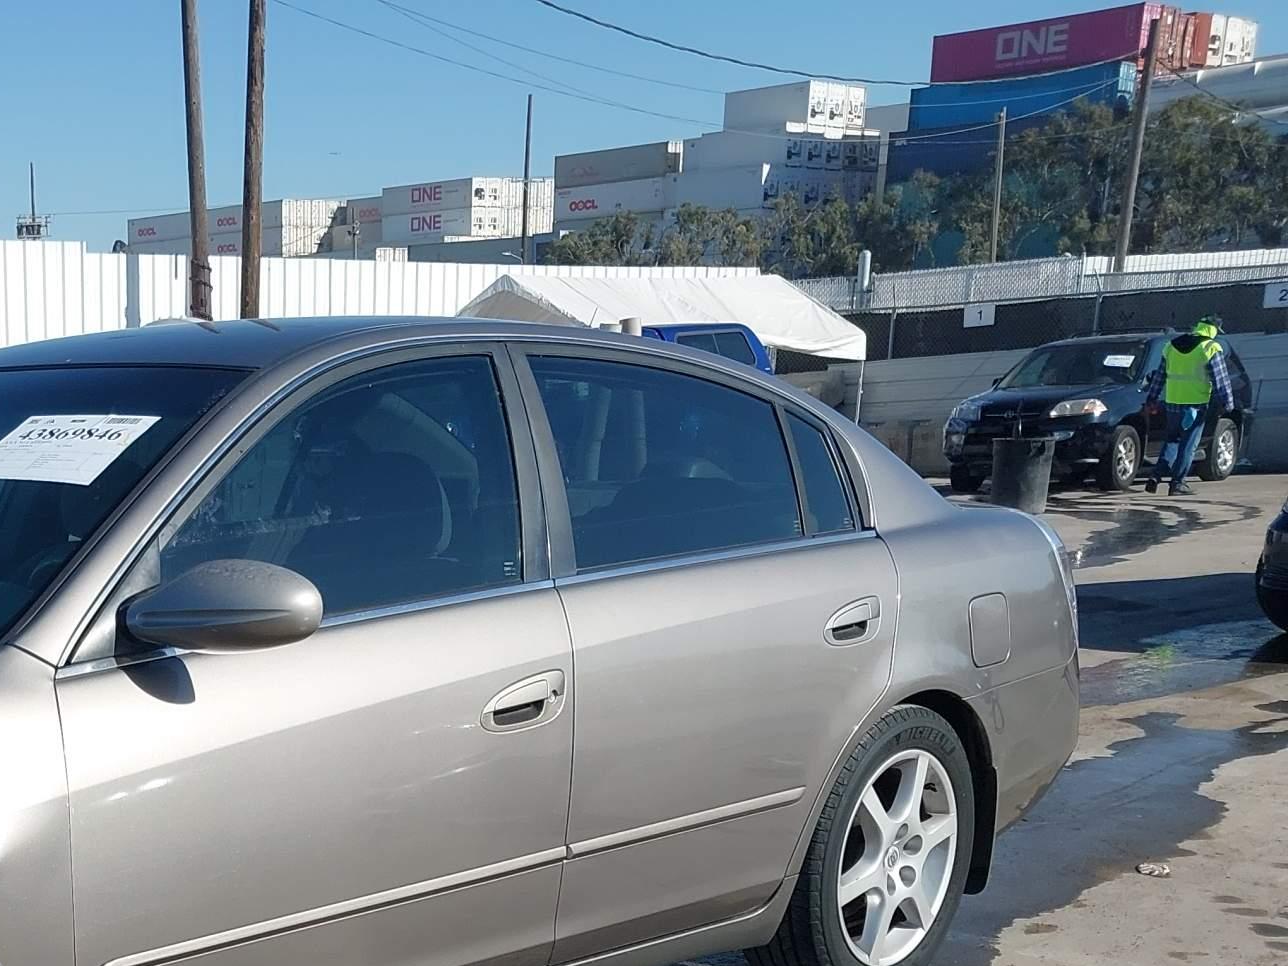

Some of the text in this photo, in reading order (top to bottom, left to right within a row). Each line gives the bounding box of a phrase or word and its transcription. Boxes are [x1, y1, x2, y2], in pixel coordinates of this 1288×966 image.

[996, 23, 1069, 60] ONE
[411, 186, 442, 203] ONE
[569, 199, 598, 211] OOCL
[411, 215, 442, 232] ONE
[977, 310, 983, 320] 1
[19, 428, 124, 441] 43869846
[899, 727, 956, 754] MICHELIN
